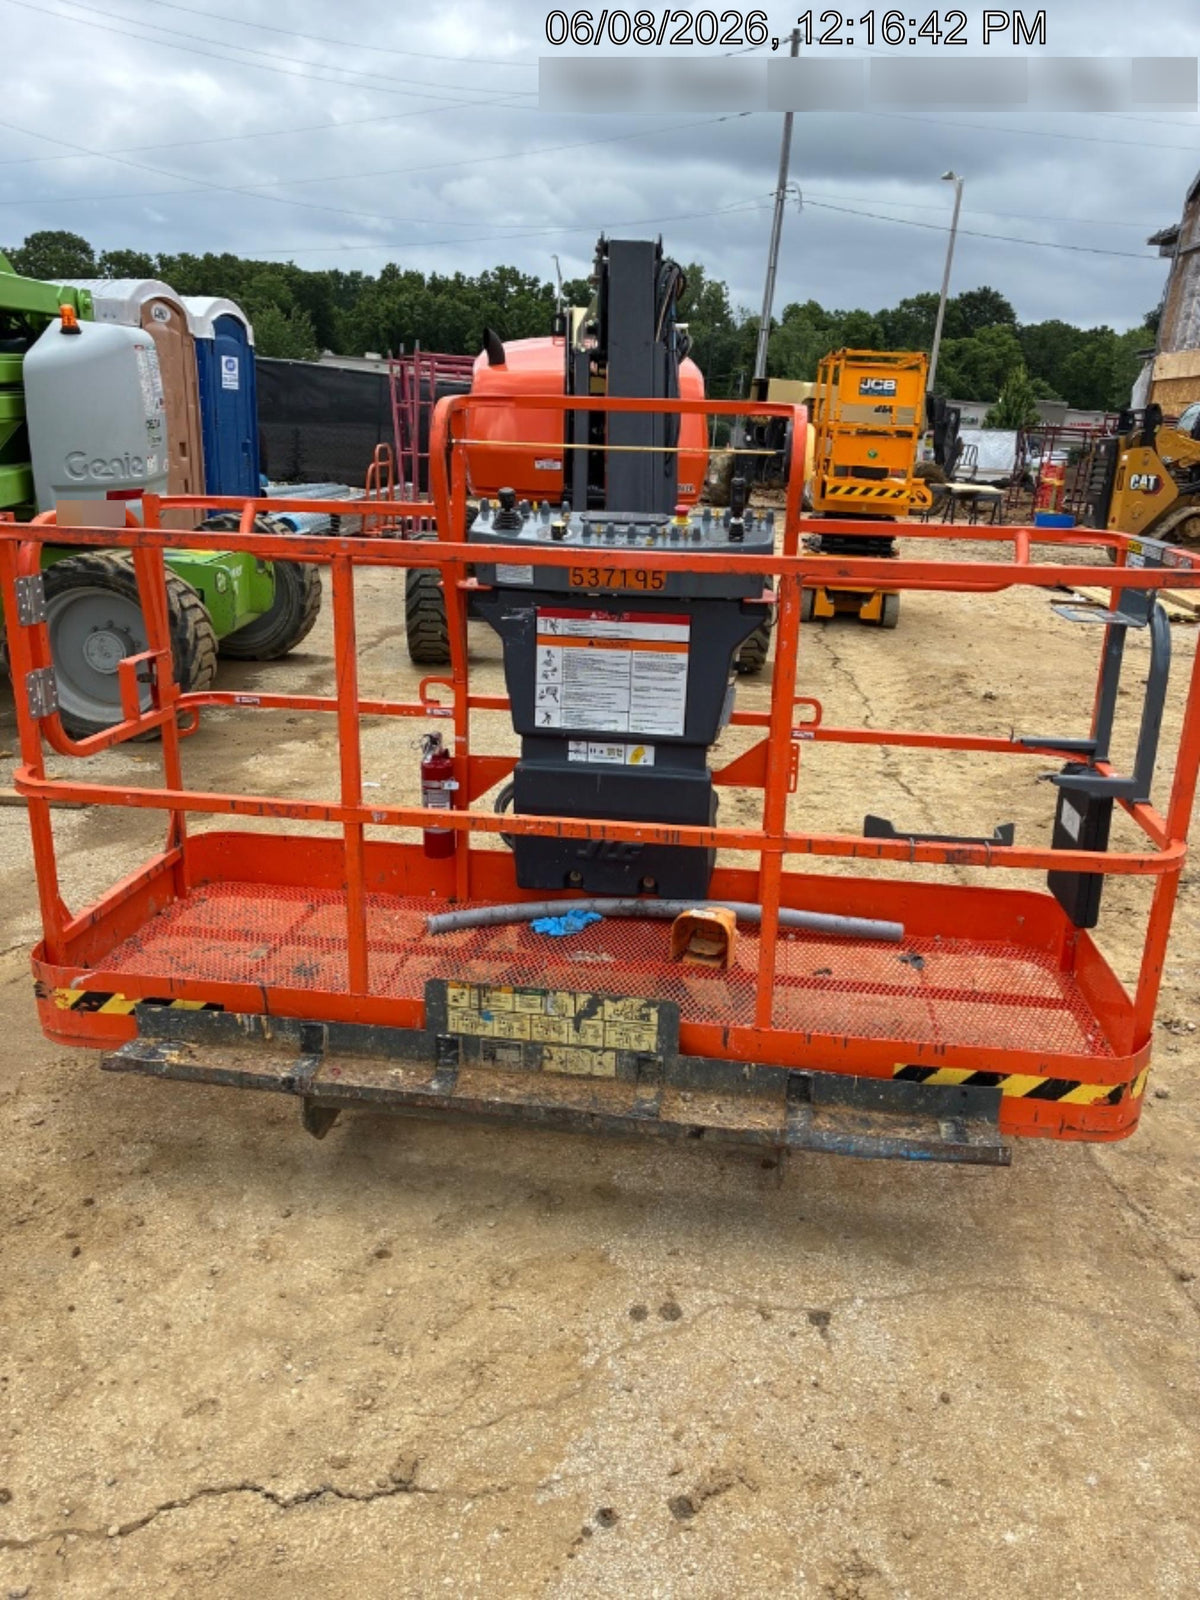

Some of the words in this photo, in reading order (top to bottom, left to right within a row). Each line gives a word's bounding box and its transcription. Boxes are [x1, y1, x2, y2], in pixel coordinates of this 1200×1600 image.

[860, 378, 896, 390] JCB
[64, 450, 143, 481] Genie
[1130, 474, 1157, 491] CAT
[572, 567, 664, 589] 537195
